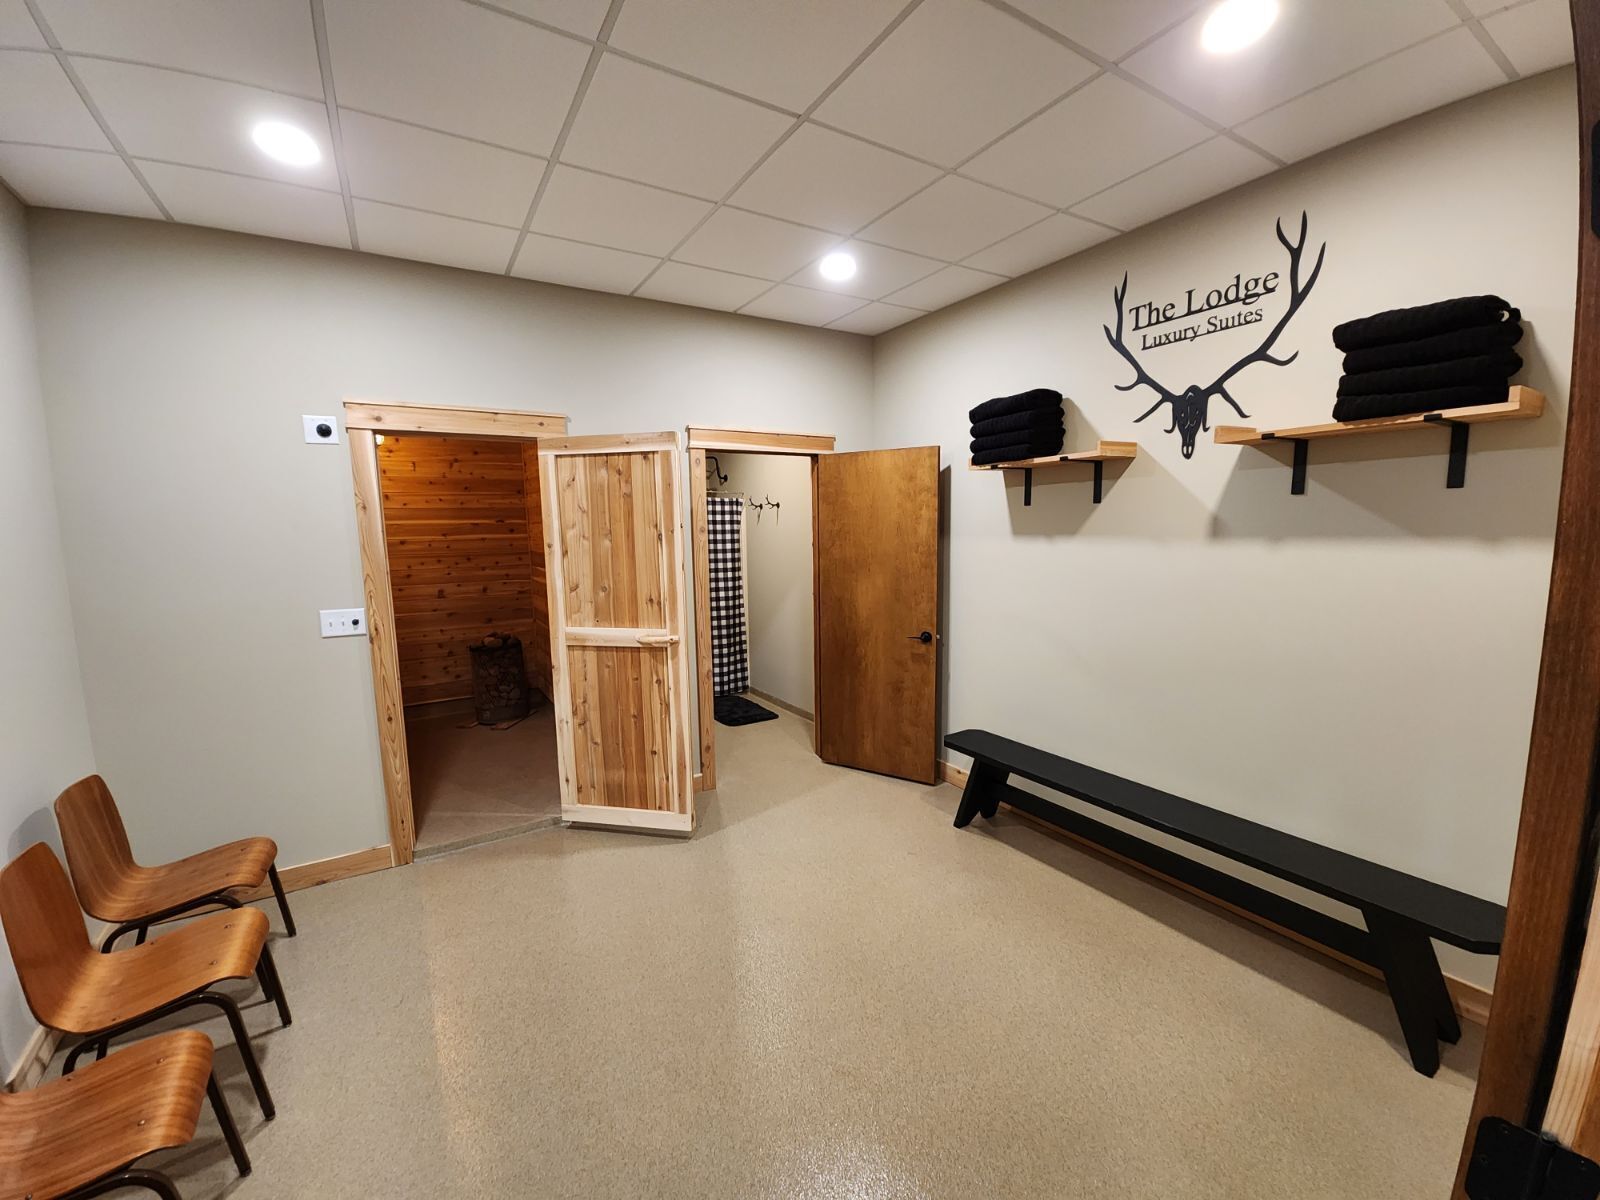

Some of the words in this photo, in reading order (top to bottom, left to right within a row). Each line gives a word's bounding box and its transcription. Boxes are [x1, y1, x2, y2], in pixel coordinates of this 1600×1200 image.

[1129, 301, 1176, 331] The
[1185, 271, 1279, 316] Lodge
[1141, 324, 1201, 350] Luxury
[1206, 308, 1263, 334] Suites
